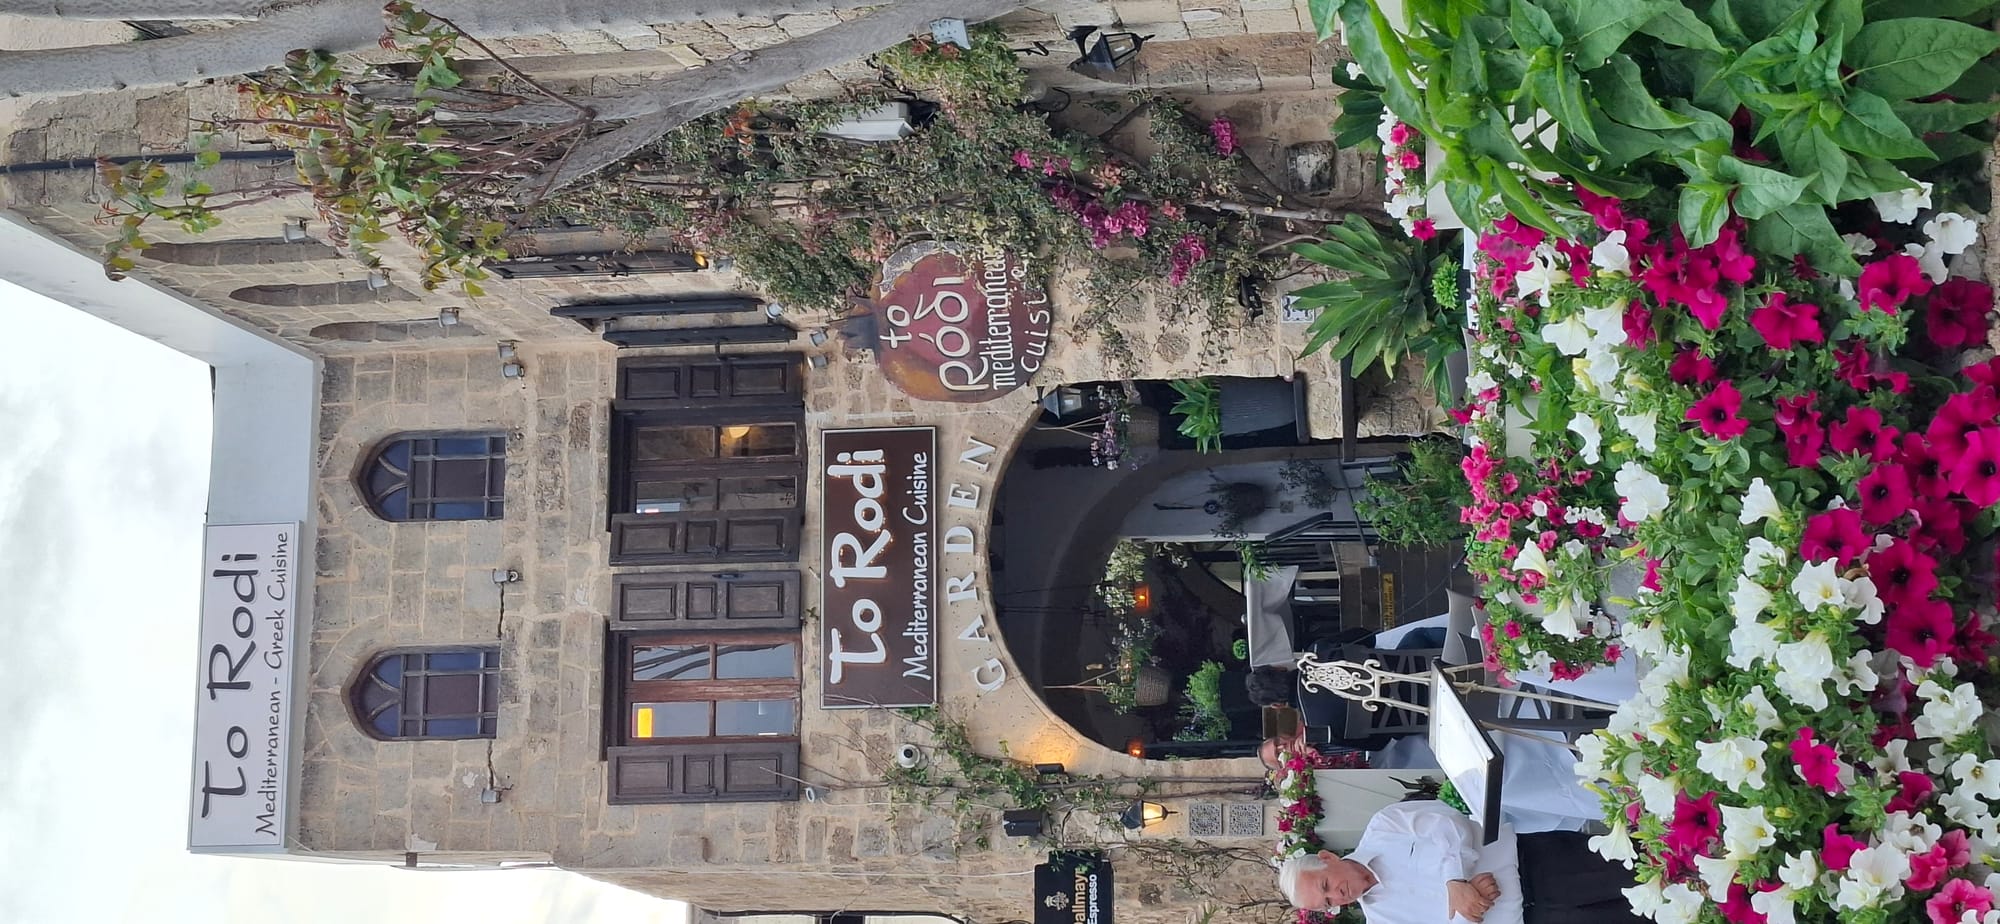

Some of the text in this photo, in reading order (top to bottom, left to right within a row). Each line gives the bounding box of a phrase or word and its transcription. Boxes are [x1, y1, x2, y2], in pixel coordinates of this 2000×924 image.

[1010, 262, 1050, 372] cuisie
[267, 532, 289, 602] Cuisine
[826, 448, 892, 684] To Rodi
[902, 452, 932, 680] Mediterranean Cuisine
[943, 436, 1008, 692] GARDEN
[201, 553, 259, 818] To Rodi
[263, 608, 286, 670] Greek
[255, 690, 281, 836] Mediterranean
[1087, 874, 1100, 924] Espresso
